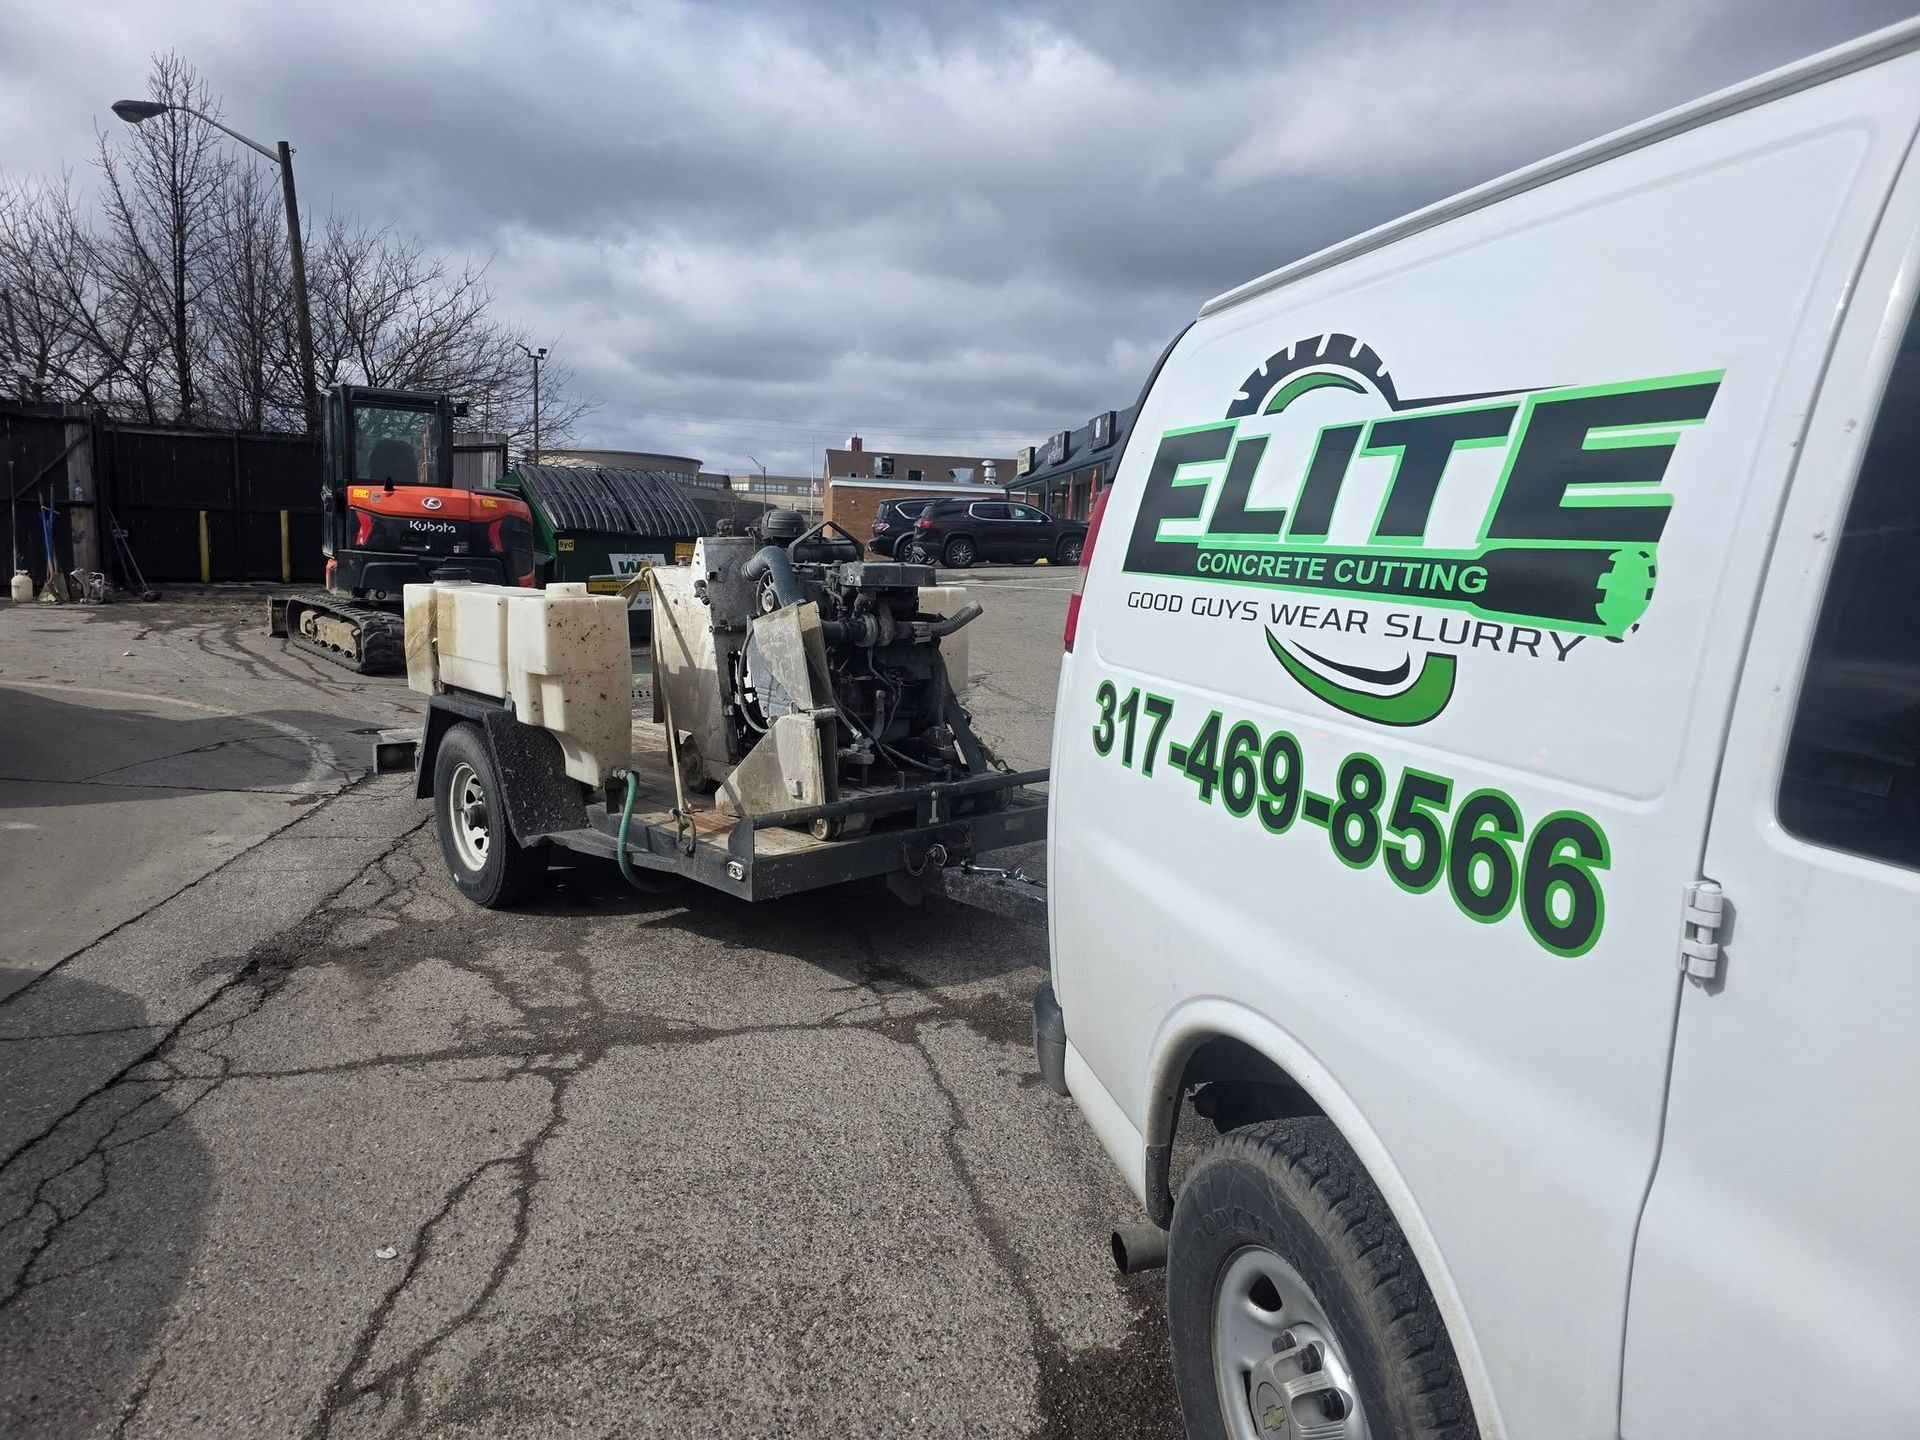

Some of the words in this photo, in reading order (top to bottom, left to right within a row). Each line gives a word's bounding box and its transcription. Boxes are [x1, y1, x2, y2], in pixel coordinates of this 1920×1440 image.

[1122, 369, 1727, 572] ELITE
[410, 520, 457, 534] Kubota
[1197, 552, 1328, 580] CONCRETE
[1334, 558, 1489, 593] CUTTING
[1128, 591, 1183, 613] GOOD
[1191, 597, 1259, 621] GUYS
[1271, 603, 1369, 634] WEAR
[1384, 613, 1587, 662] SLURRY
[1092, 679, 1612, 958] 317-469-8566
